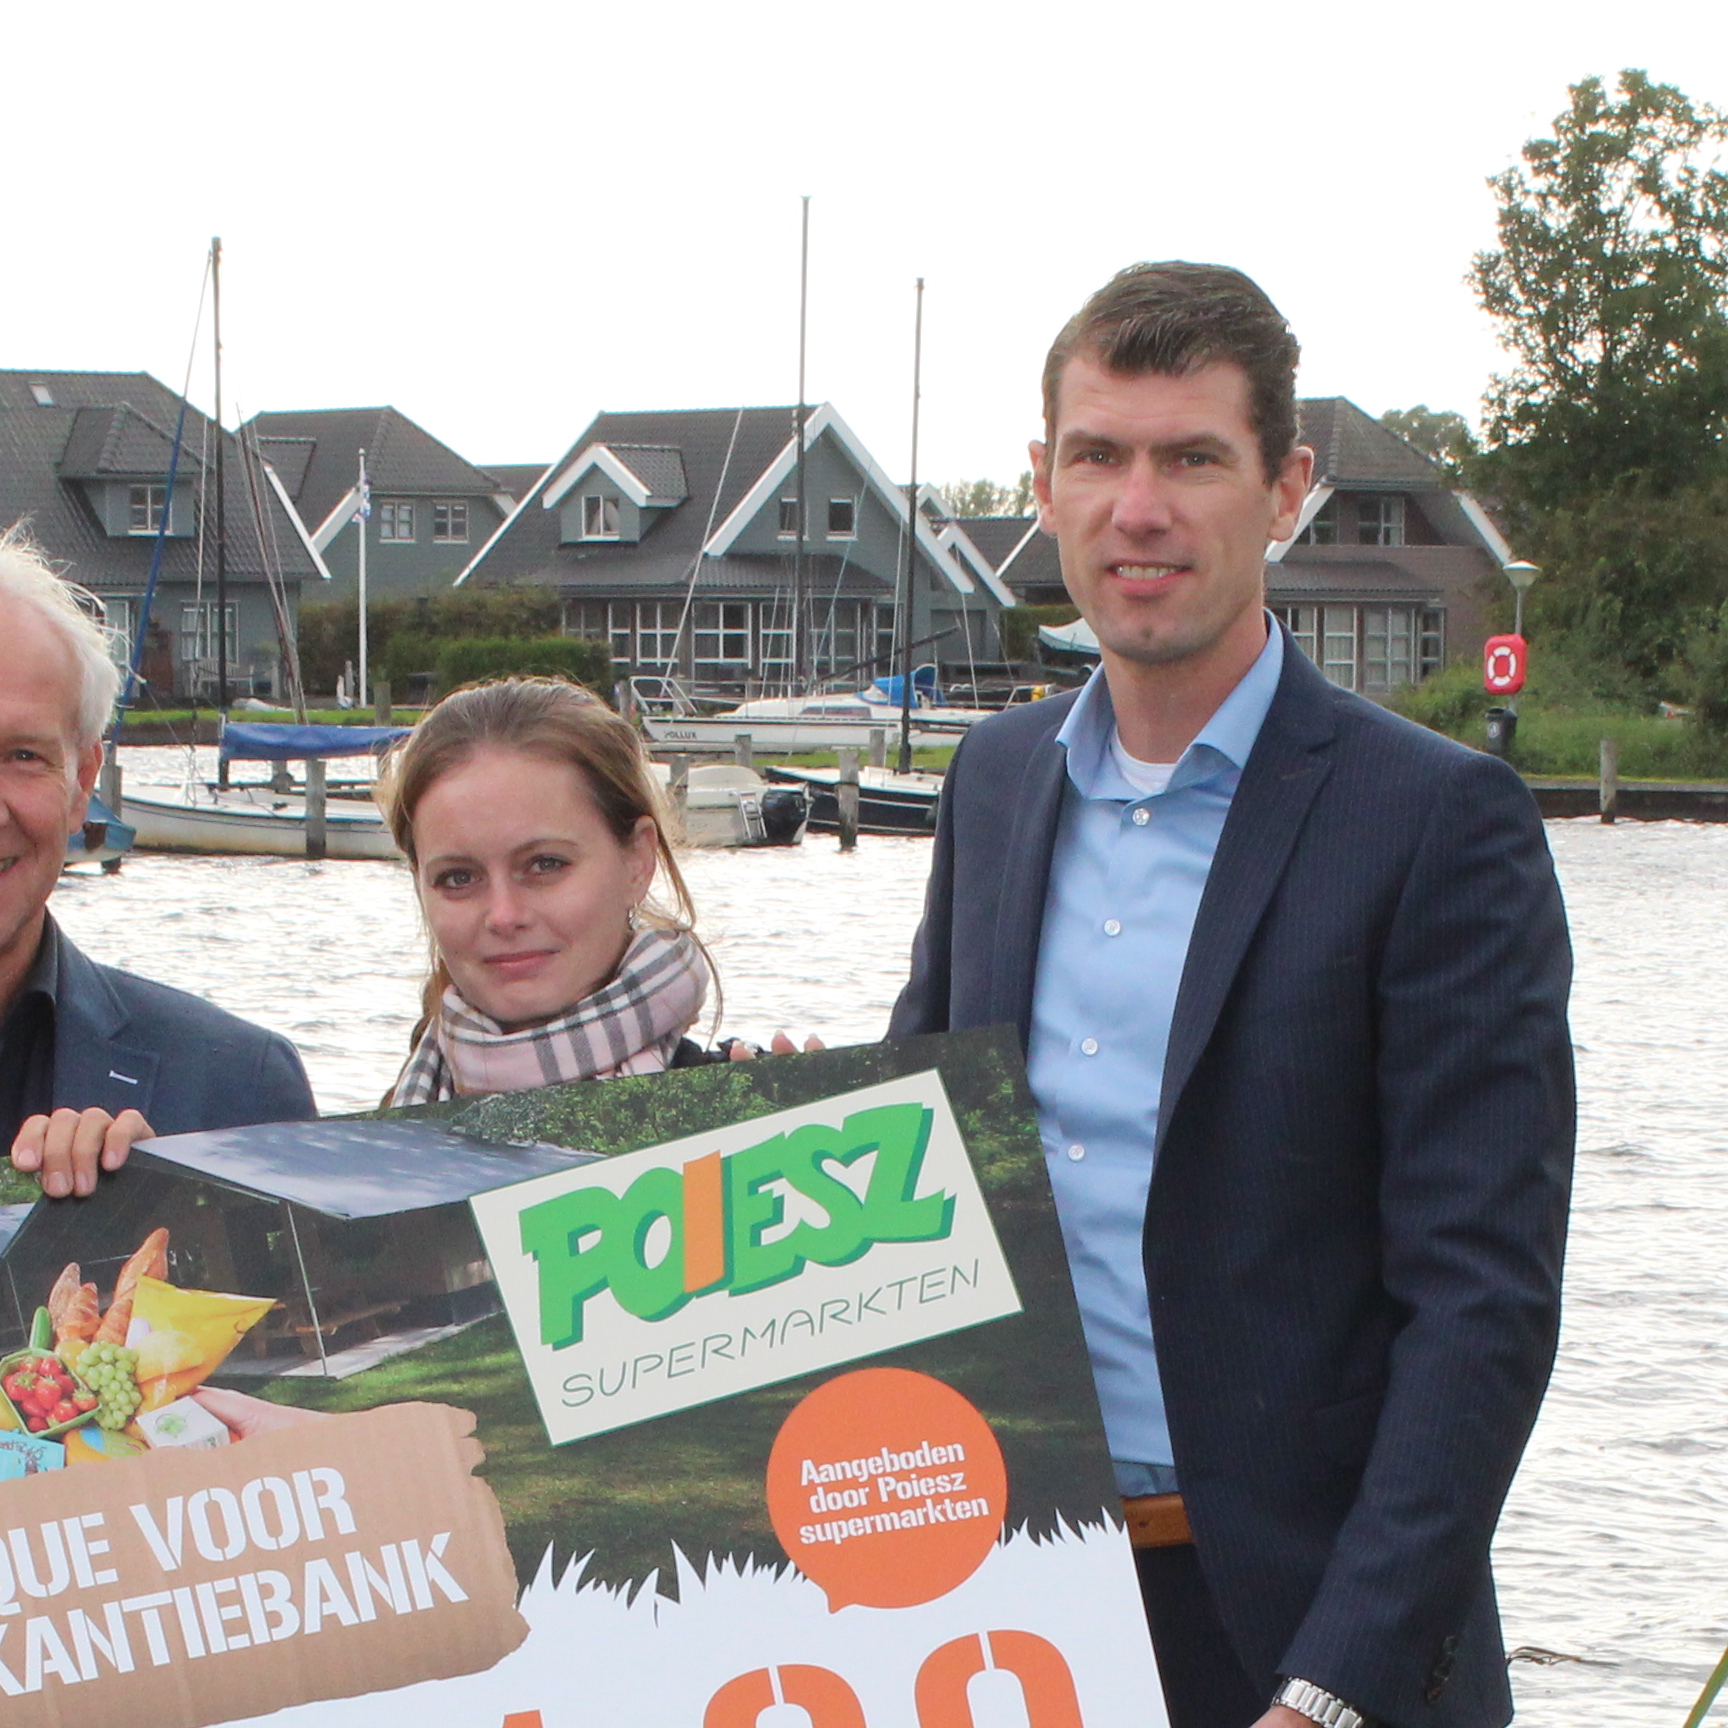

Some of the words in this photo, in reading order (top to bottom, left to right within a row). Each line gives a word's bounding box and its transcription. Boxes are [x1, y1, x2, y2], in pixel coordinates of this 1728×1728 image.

[518, 1102, 957, 1351] POIESZ
[560, 1258, 980, 1408] SUPERMARKTEN
[799, 1440, 966, 1487] Aangeboden
[809, 1486, 870, 1514] door
[876, 1472, 968, 1503] Poiesz
[129, 1467, 357, 1573] VOOR
[798, 1497, 990, 1545] supermarkten
